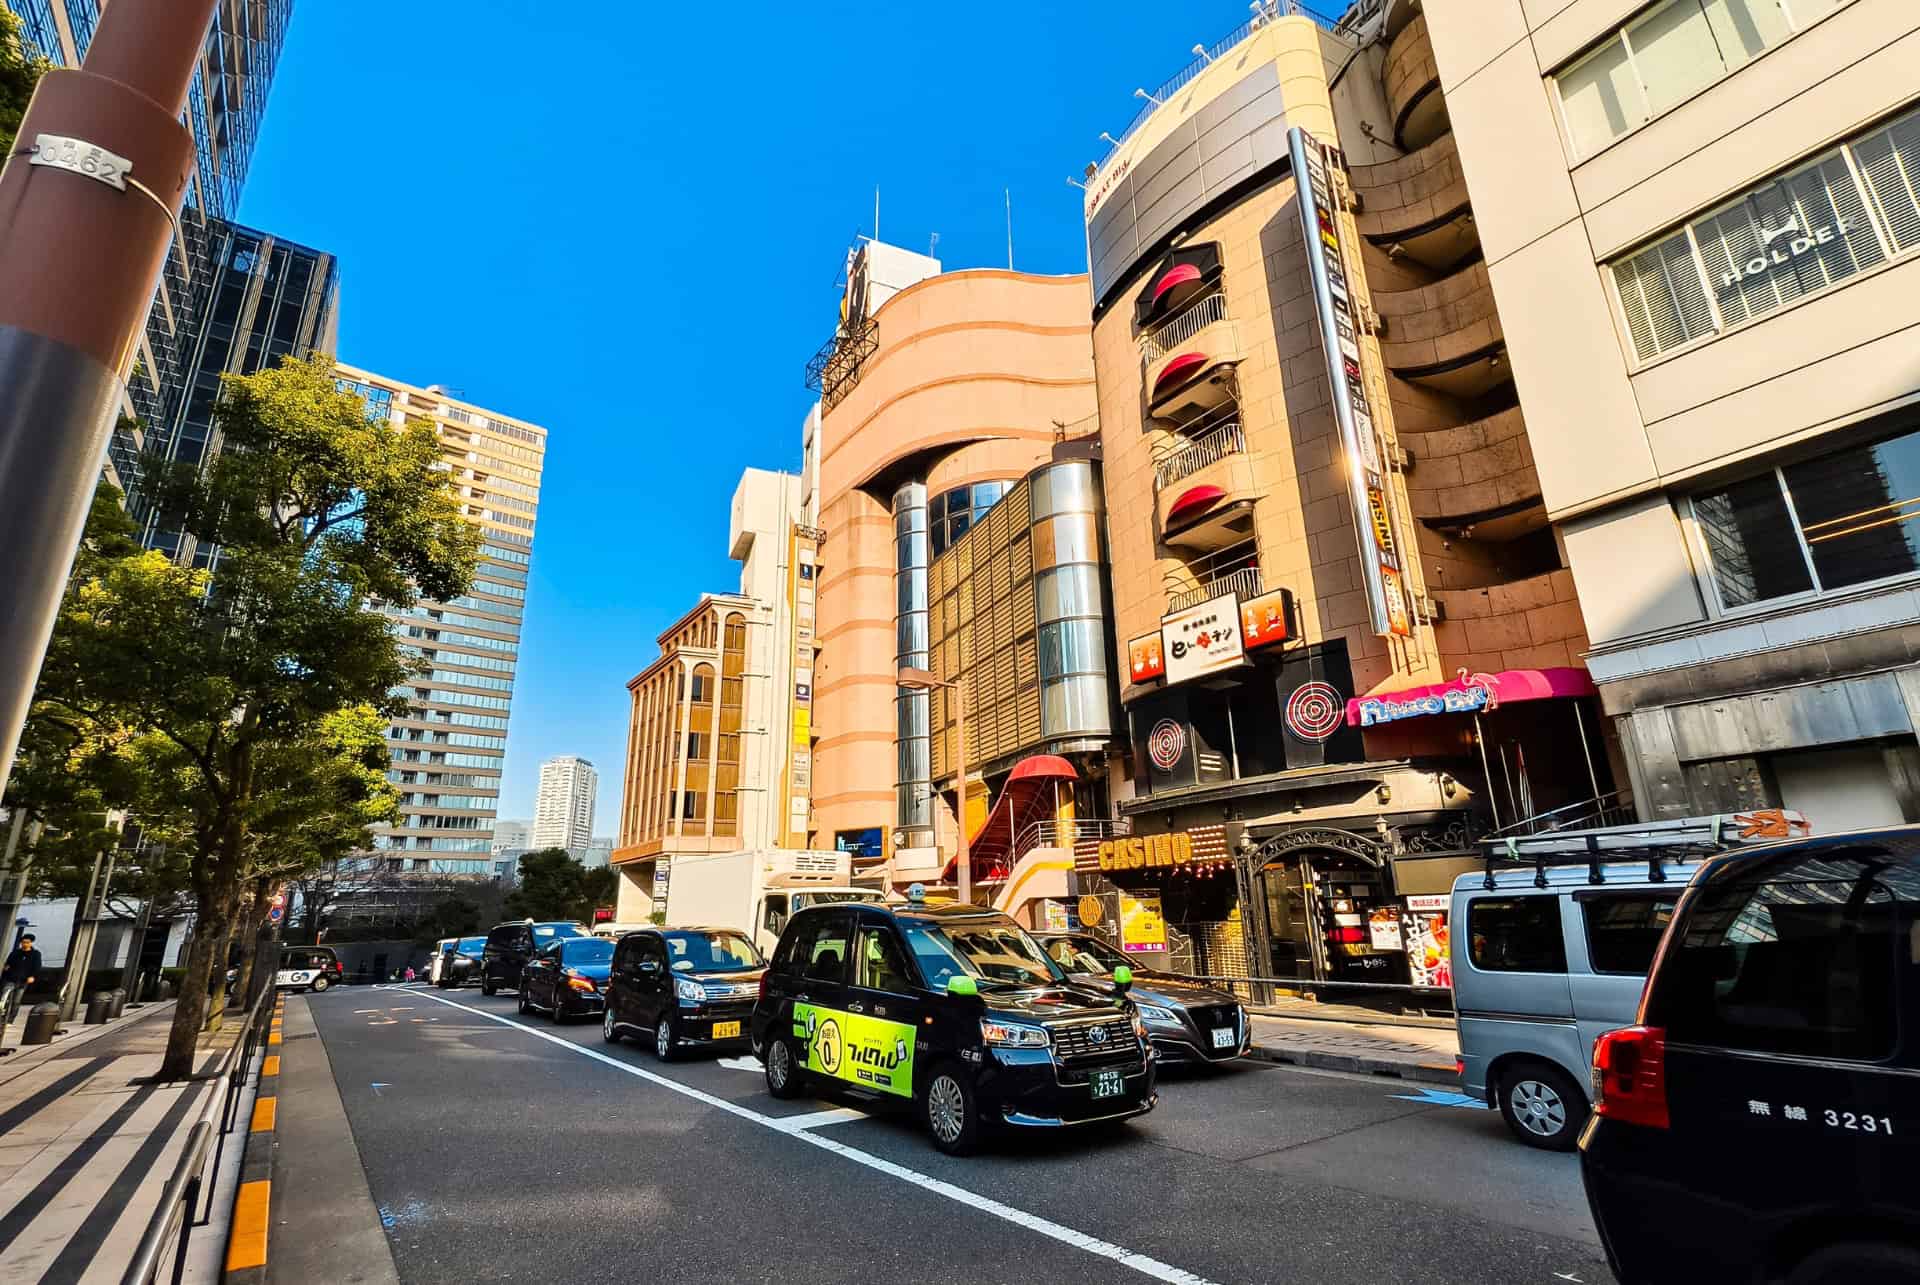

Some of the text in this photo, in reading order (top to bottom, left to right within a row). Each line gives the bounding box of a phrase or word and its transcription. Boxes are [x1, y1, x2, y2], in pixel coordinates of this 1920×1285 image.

[1721, 216, 1858, 287] HOLDER
[1098, 831, 1193, 871] CASINO
[1823, 1109, 1894, 1136] 3231
